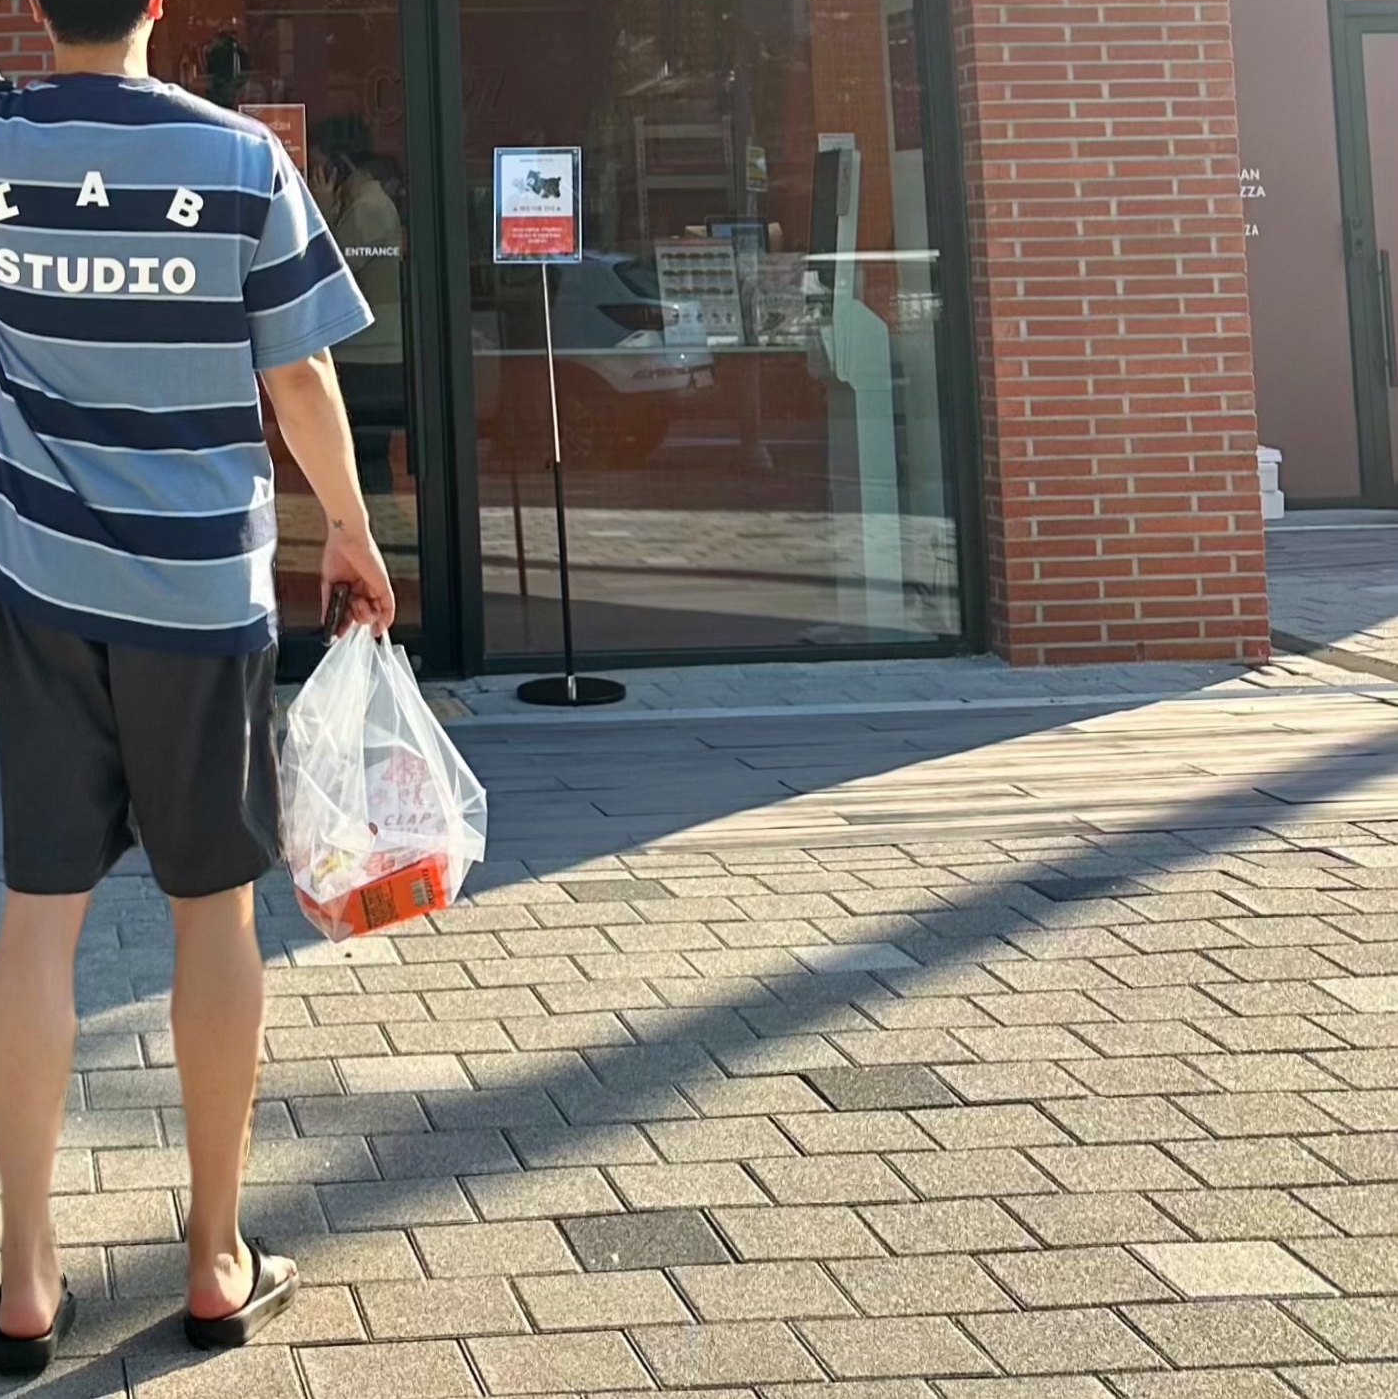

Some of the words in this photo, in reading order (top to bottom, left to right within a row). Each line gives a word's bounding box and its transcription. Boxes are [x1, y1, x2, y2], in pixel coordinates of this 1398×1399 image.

[1240, 168, 1260, 181] AN
[1239, 185, 1267, 198] ZZA
[344, 246, 401, 257] ENTRANCE
[384, 812, 432, 826] CLAP
